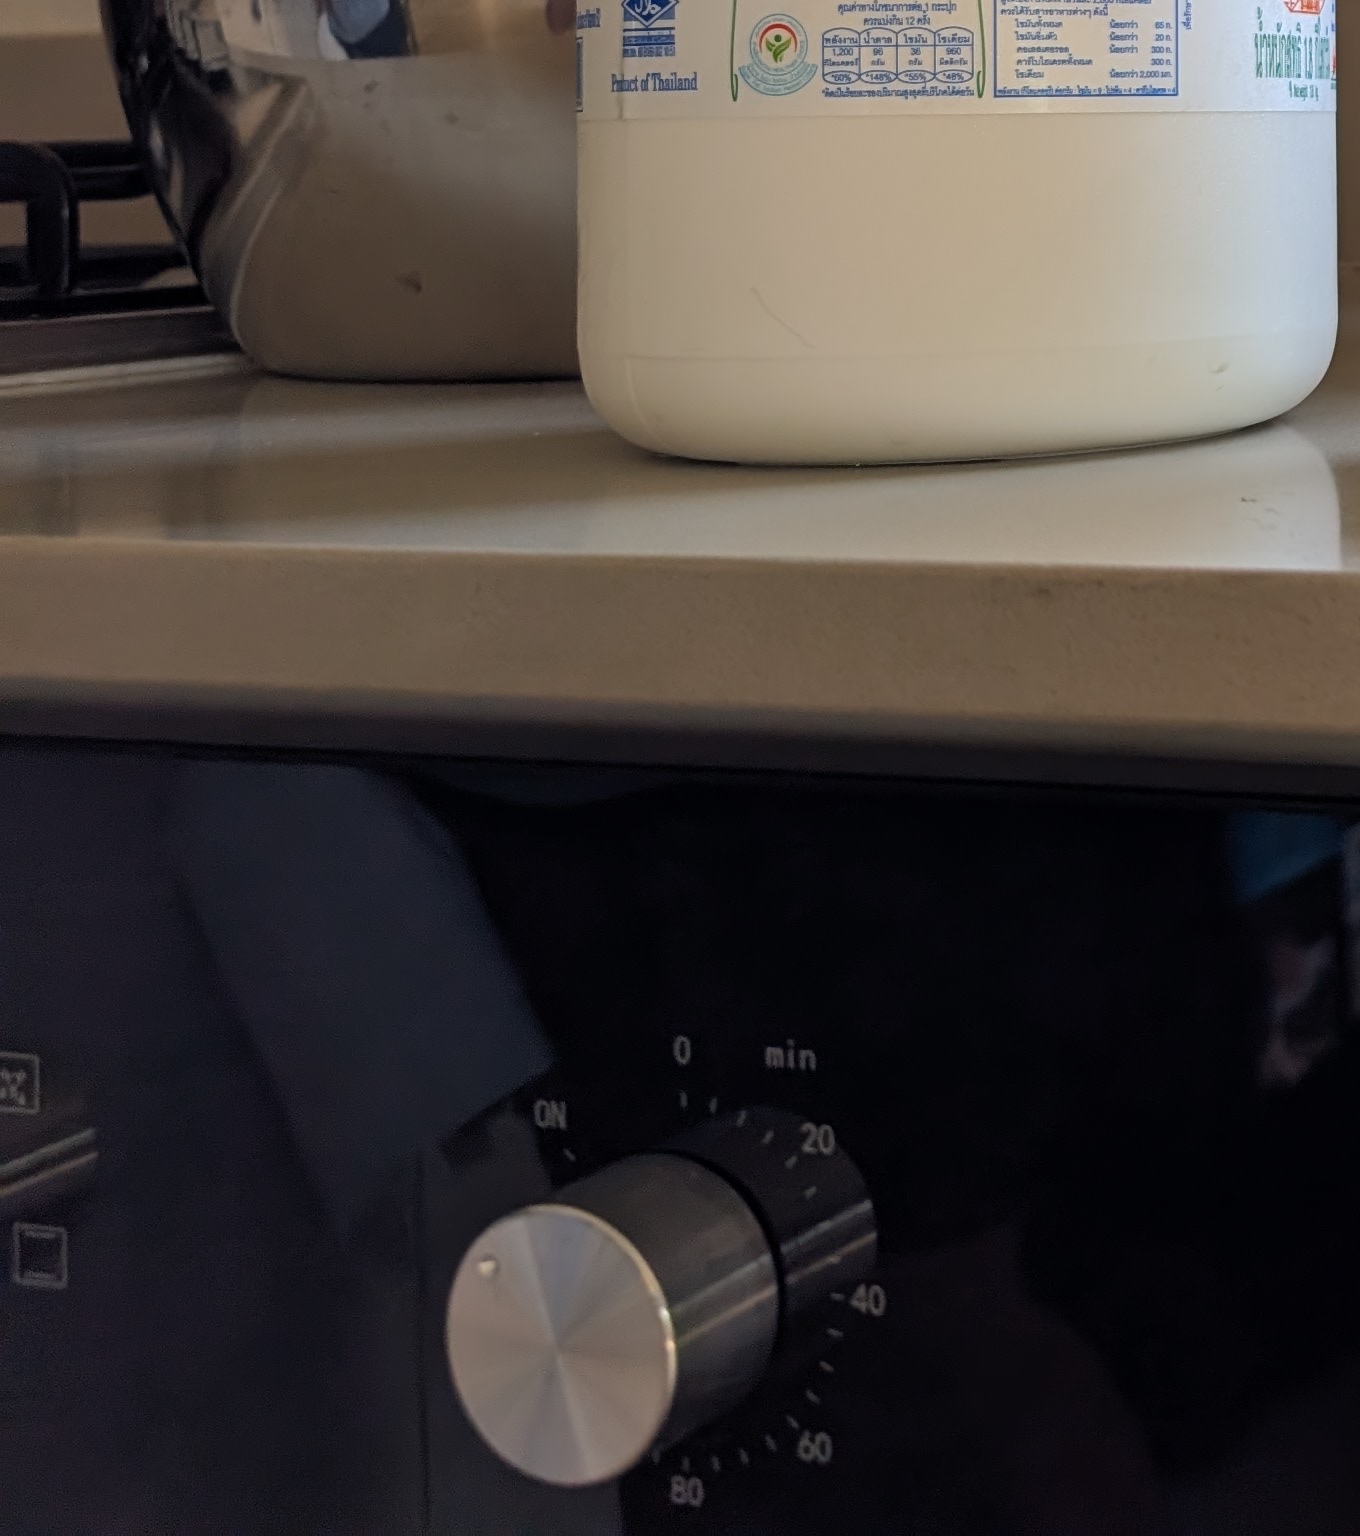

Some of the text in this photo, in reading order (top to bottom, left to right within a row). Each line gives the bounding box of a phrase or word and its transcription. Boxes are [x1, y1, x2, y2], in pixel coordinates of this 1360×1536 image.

[905, 16, 915, 26] 12
[641, 71, 650, 91] of
[652, 70, 698, 92] Thailand
[673, 1035, 691, 1066] 0
[764, 1037, 817, 1071] min
[533, 1098, 567, 1131] ON
[801, 1121, 836, 1156] 20
[850, 1283, 887, 1318] 40
[797, 1430, 833, 1465] 60
[670, 1475, 705, 1508] 80
